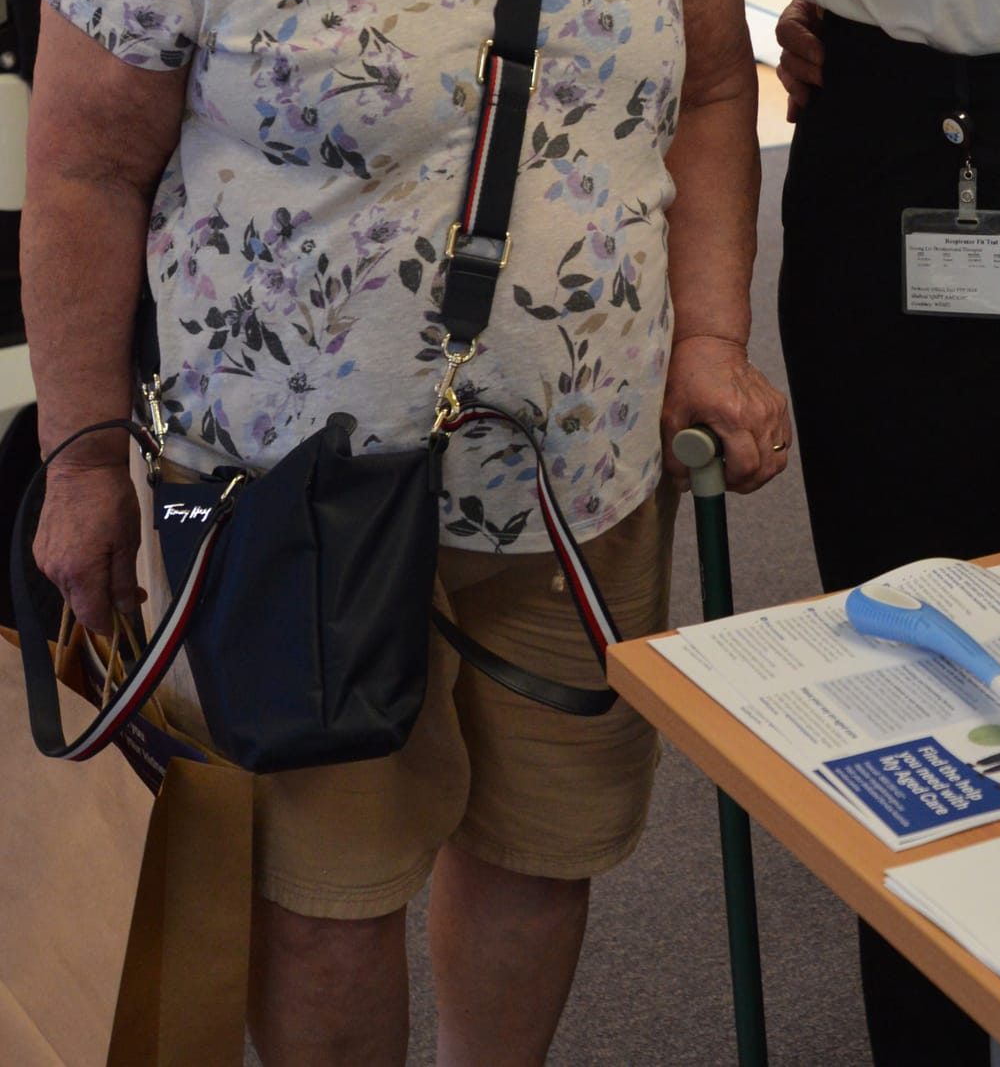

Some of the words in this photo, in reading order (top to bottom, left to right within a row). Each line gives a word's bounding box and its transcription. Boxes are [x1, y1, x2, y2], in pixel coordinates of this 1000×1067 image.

[880, 755, 901, 772] My
[894, 770, 929, 796] Aged
[920, 791, 949, 816] Care
[897, 750, 922, 770] you
[916, 766, 950, 792] need
[941, 787, 970, 811] with
[918, 745, 949, 768] Find
[939, 762, 961, 782] the
[956, 779, 983, 802] help
